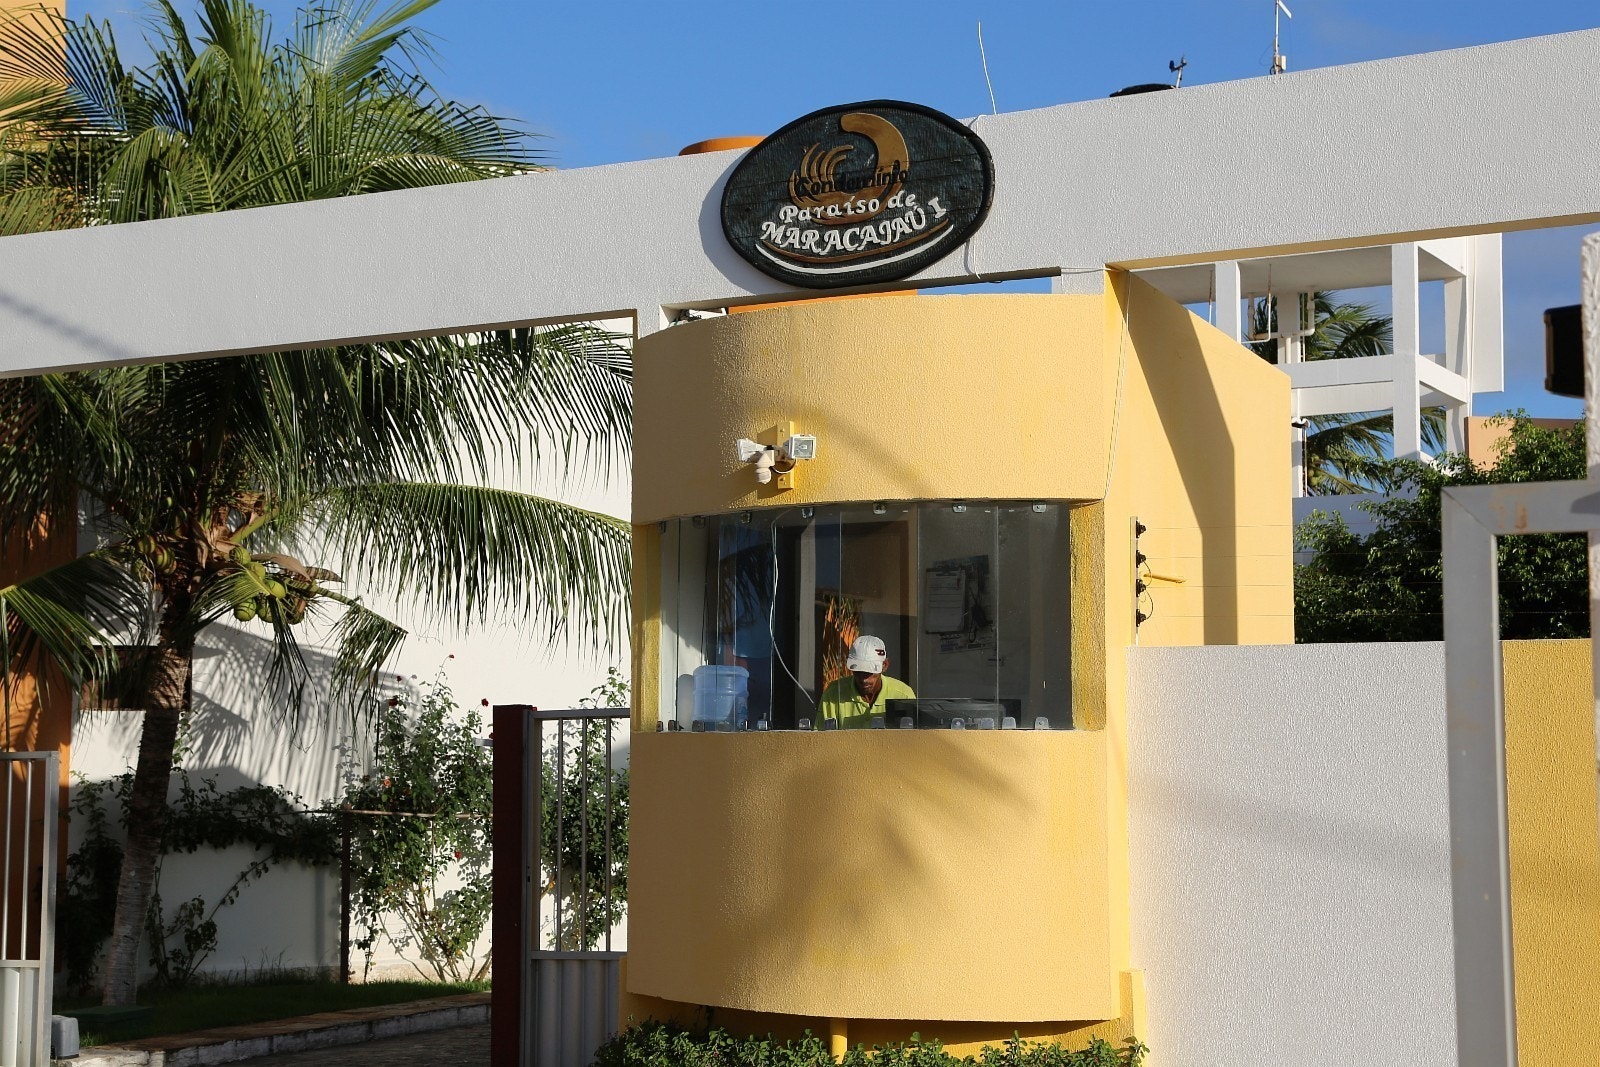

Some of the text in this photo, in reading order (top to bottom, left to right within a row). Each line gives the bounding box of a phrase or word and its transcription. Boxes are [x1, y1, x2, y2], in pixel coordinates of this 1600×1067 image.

[778, 190, 916, 224] Paraíso de
[760, 205, 926, 256] MARACAJAÚ
